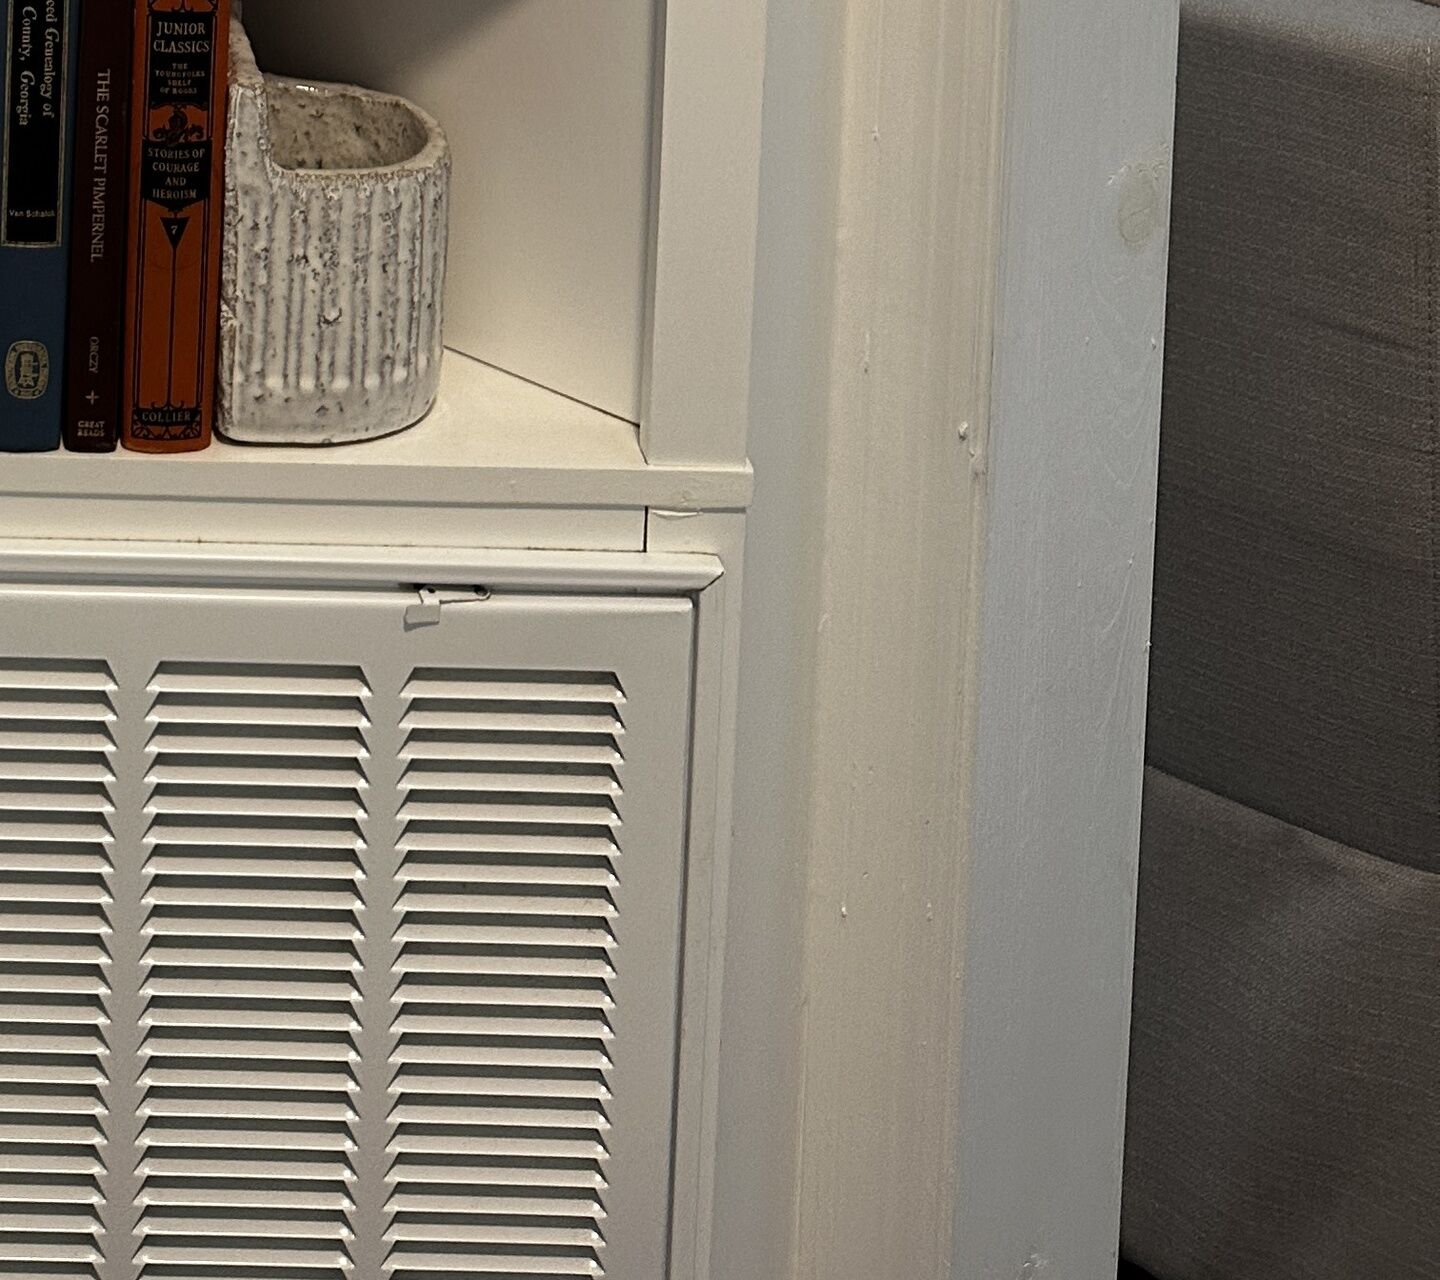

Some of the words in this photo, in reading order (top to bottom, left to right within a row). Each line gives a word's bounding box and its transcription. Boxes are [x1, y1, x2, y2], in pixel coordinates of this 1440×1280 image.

[18, 5, 37, 61] County,
[156, 21, 206, 37] JUNIOR
[153, 40, 210, 53] CLASSICS
[40, 28, 60, 100] Genealogy
[172, 62, 188, 70] THE
[96, 68, 111, 102] THE
[16, 70, 36, 126] Georgia
[42, 103, 54, 118] of
[93, 105, 109, 175] SCARLET
[147, 147, 190, 159] STORIES
[192, 148, 206, 159] OF
[152, 162, 200, 174] COURAGE
[164, 176, 187, 186] AND
[152, 188, 197, 200] HEROISM
[90, 177, 107, 263] PIMPERNEL
[170, 225, 178, 235] 7
[88, 336, 100, 374] ORCZY
[142, 411, 191, 423] COLLIER
